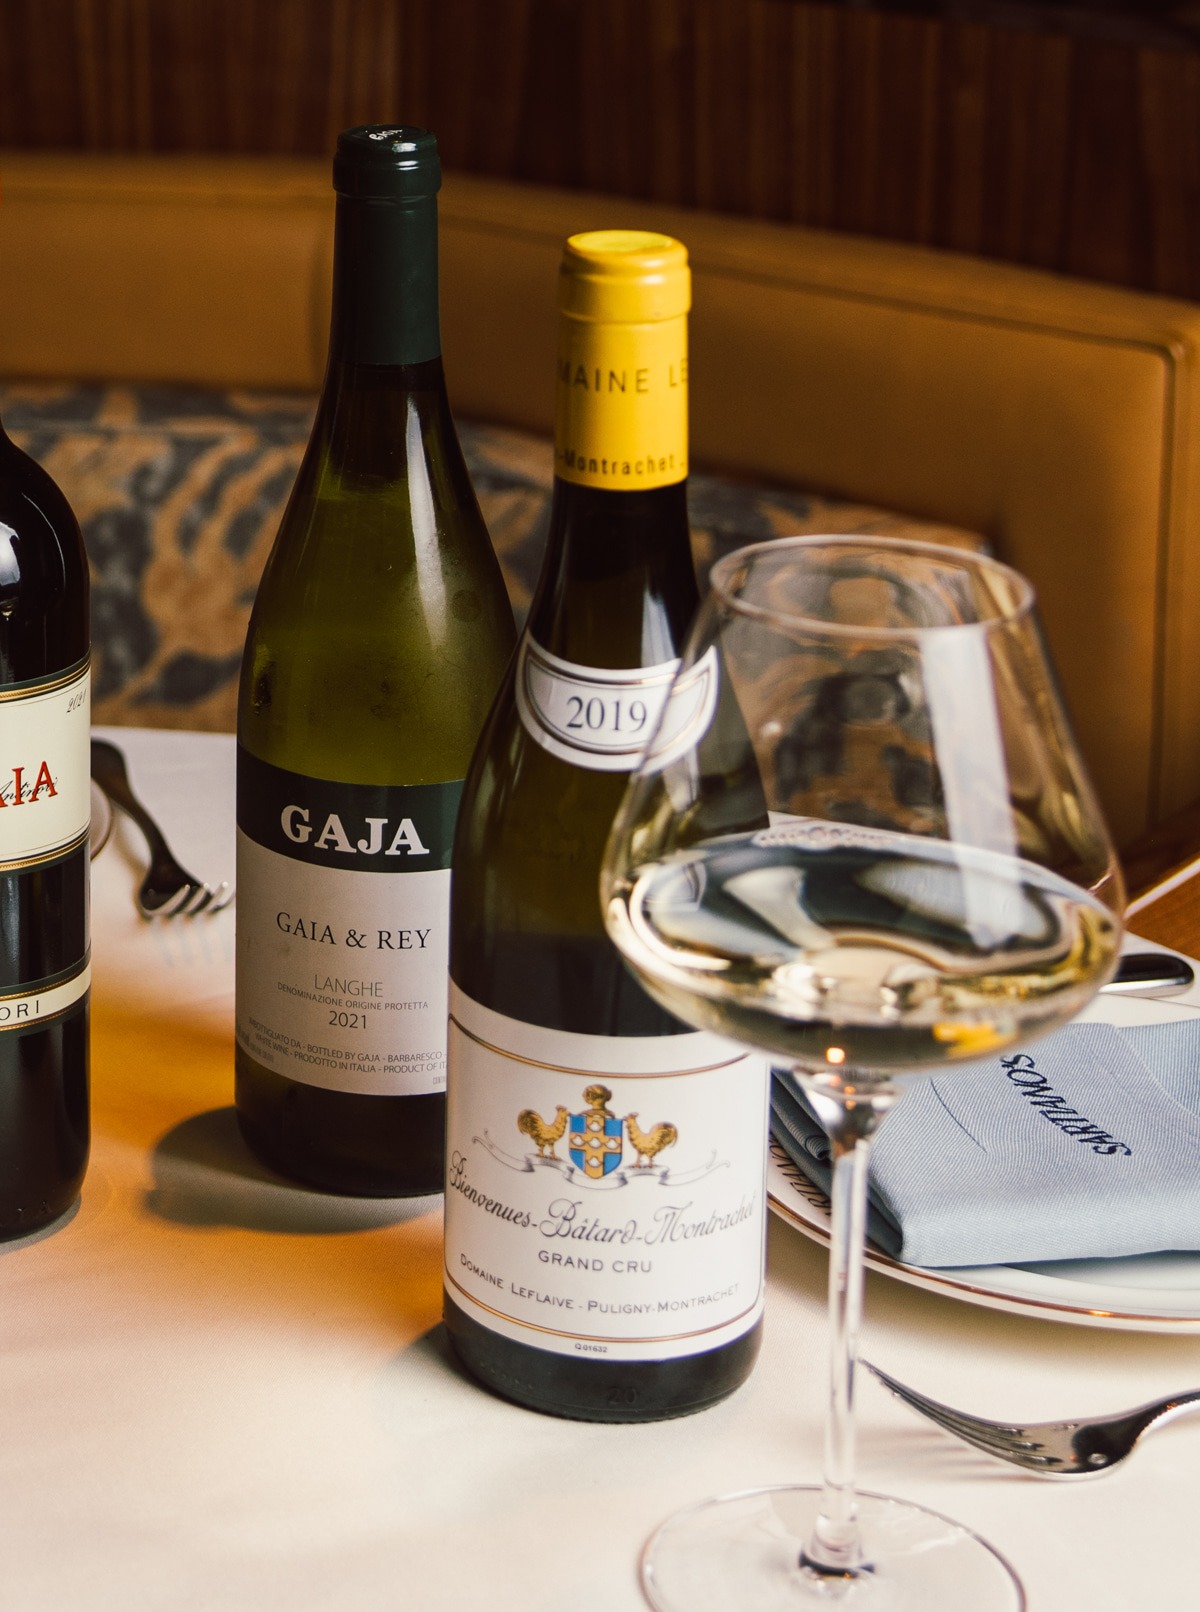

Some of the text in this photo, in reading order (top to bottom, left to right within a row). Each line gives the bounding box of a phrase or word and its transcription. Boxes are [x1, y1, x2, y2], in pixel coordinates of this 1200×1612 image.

[566, 696, 647, 732] 2019
[281, 804, 430, 855] GAJA
[276, 912, 432, 950] GAIA & REY
[277, 982, 429, 1011] DENOMINAZIONE ORIGINE PROTETTA
[314, 974, 383, 998] LANGHE
[329, 1011, 367, 1029] 2021
[291, 1040, 302, 1049] DA
[307, 1043, 343, 1059] BOTTLED
[345, 1052, 356, 1060] BY
[358, 1053, 380, 1062] GAJA
[388, 1051, 442, 1063] BARBARESCO
[294, 1051, 338, 1069] PRODOTTO
[339, 1061, 348, 1070] IN
[350, 1062, 376, 1073] ITALIA
[384, 1064, 425, 1074] PRODUCT
[426, 1062, 437, 1071] OF
[538, 1250, 652, 1273] GRAND CRU
[460, 1253, 504, 1289] DOMAINE
[511, 1282, 574, 1310] LEFLAIVE
